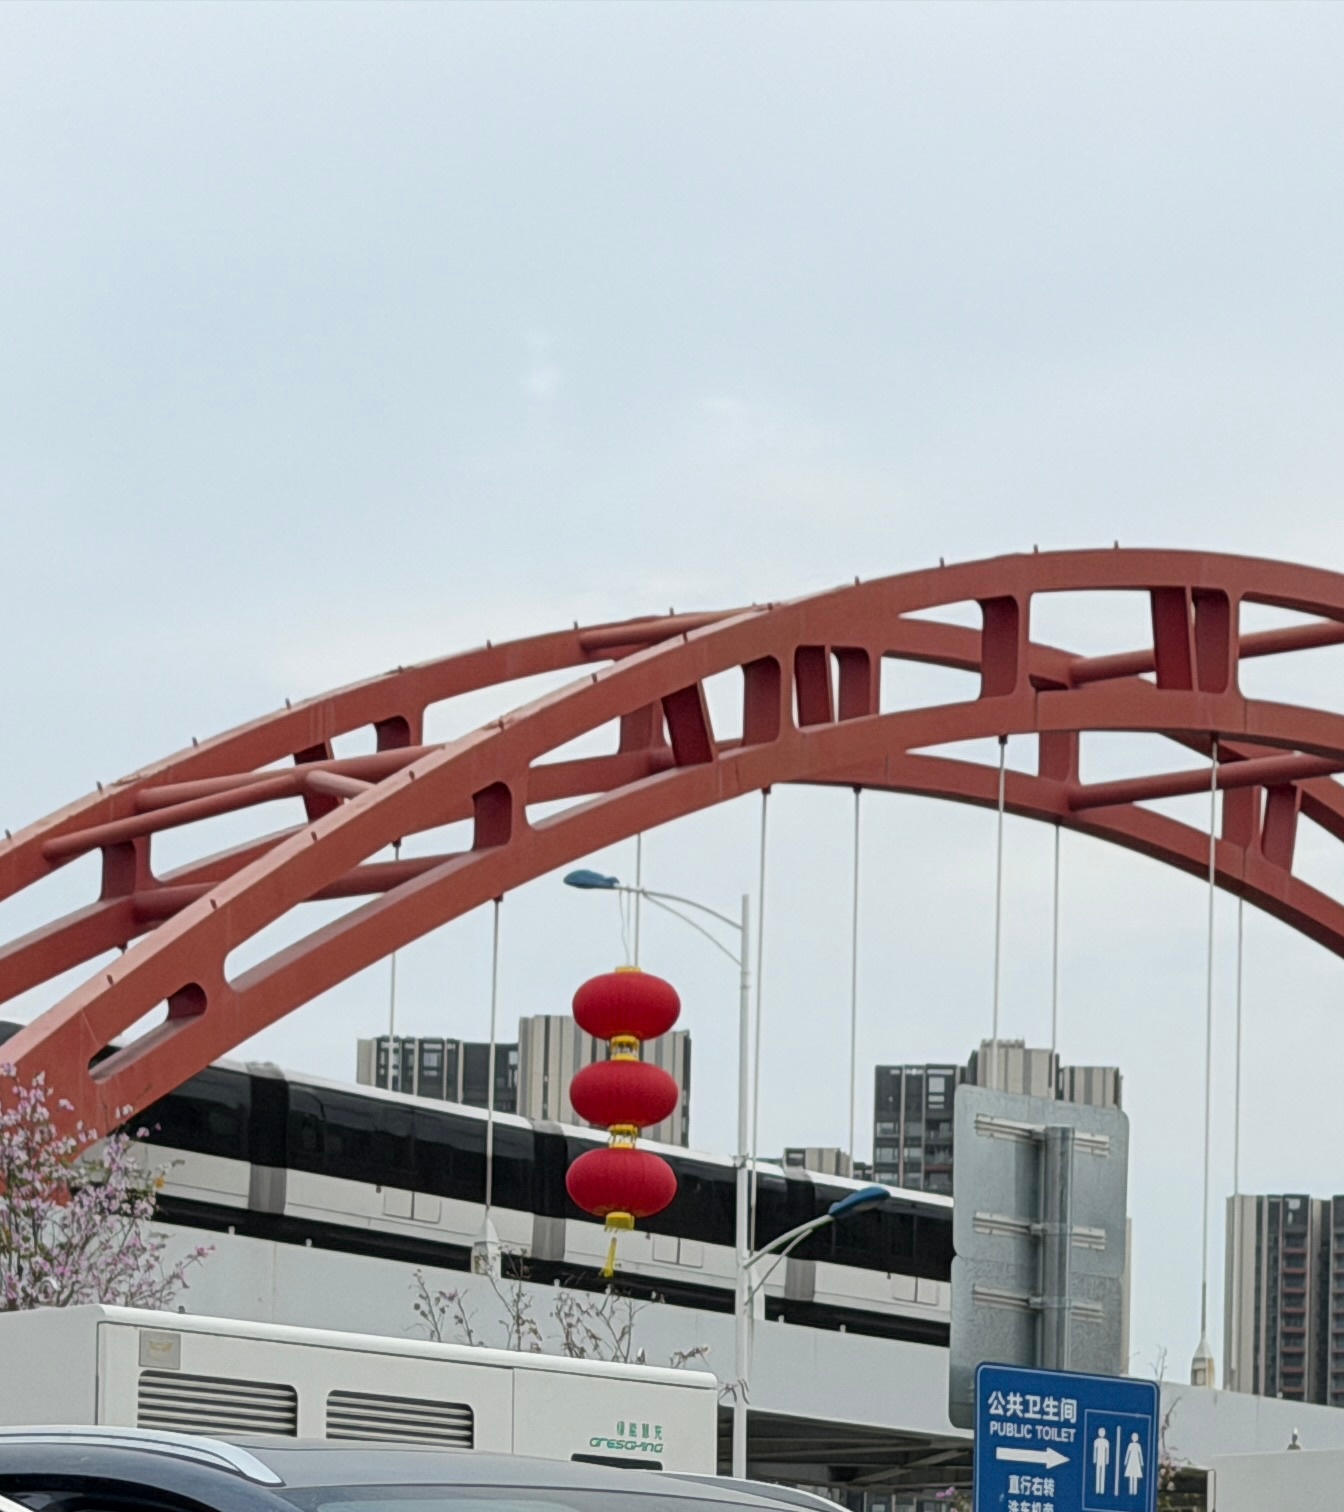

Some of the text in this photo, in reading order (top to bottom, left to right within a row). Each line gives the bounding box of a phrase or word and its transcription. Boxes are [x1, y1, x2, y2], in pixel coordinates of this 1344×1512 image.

[987, 1391, 1077, 1424] 公共卫生间
[989, 1420, 1076, 1442] PUBLIC TOILET
[1007, 1474, 1055, 1497] 直行右转
